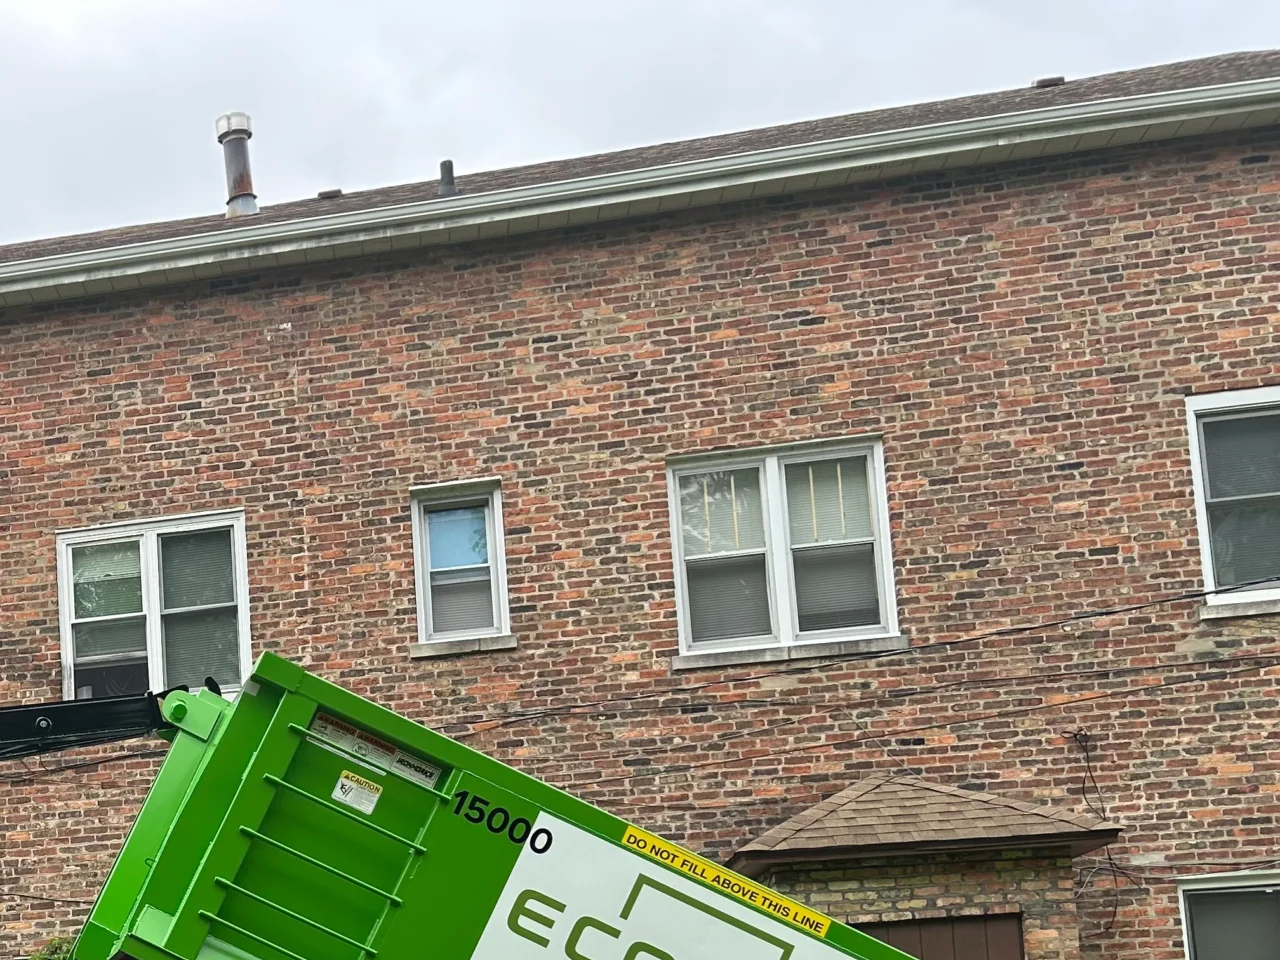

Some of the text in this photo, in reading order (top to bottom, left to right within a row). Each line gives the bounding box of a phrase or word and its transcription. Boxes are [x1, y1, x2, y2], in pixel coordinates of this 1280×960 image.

[350, 774, 381, 795] CAUTION
[396, 757, 435, 779] IRONWORKS
[452, 790, 554, 854] 15000
[626, 834, 825, 934] DO NOT FILL ABOVE THIS LINE
